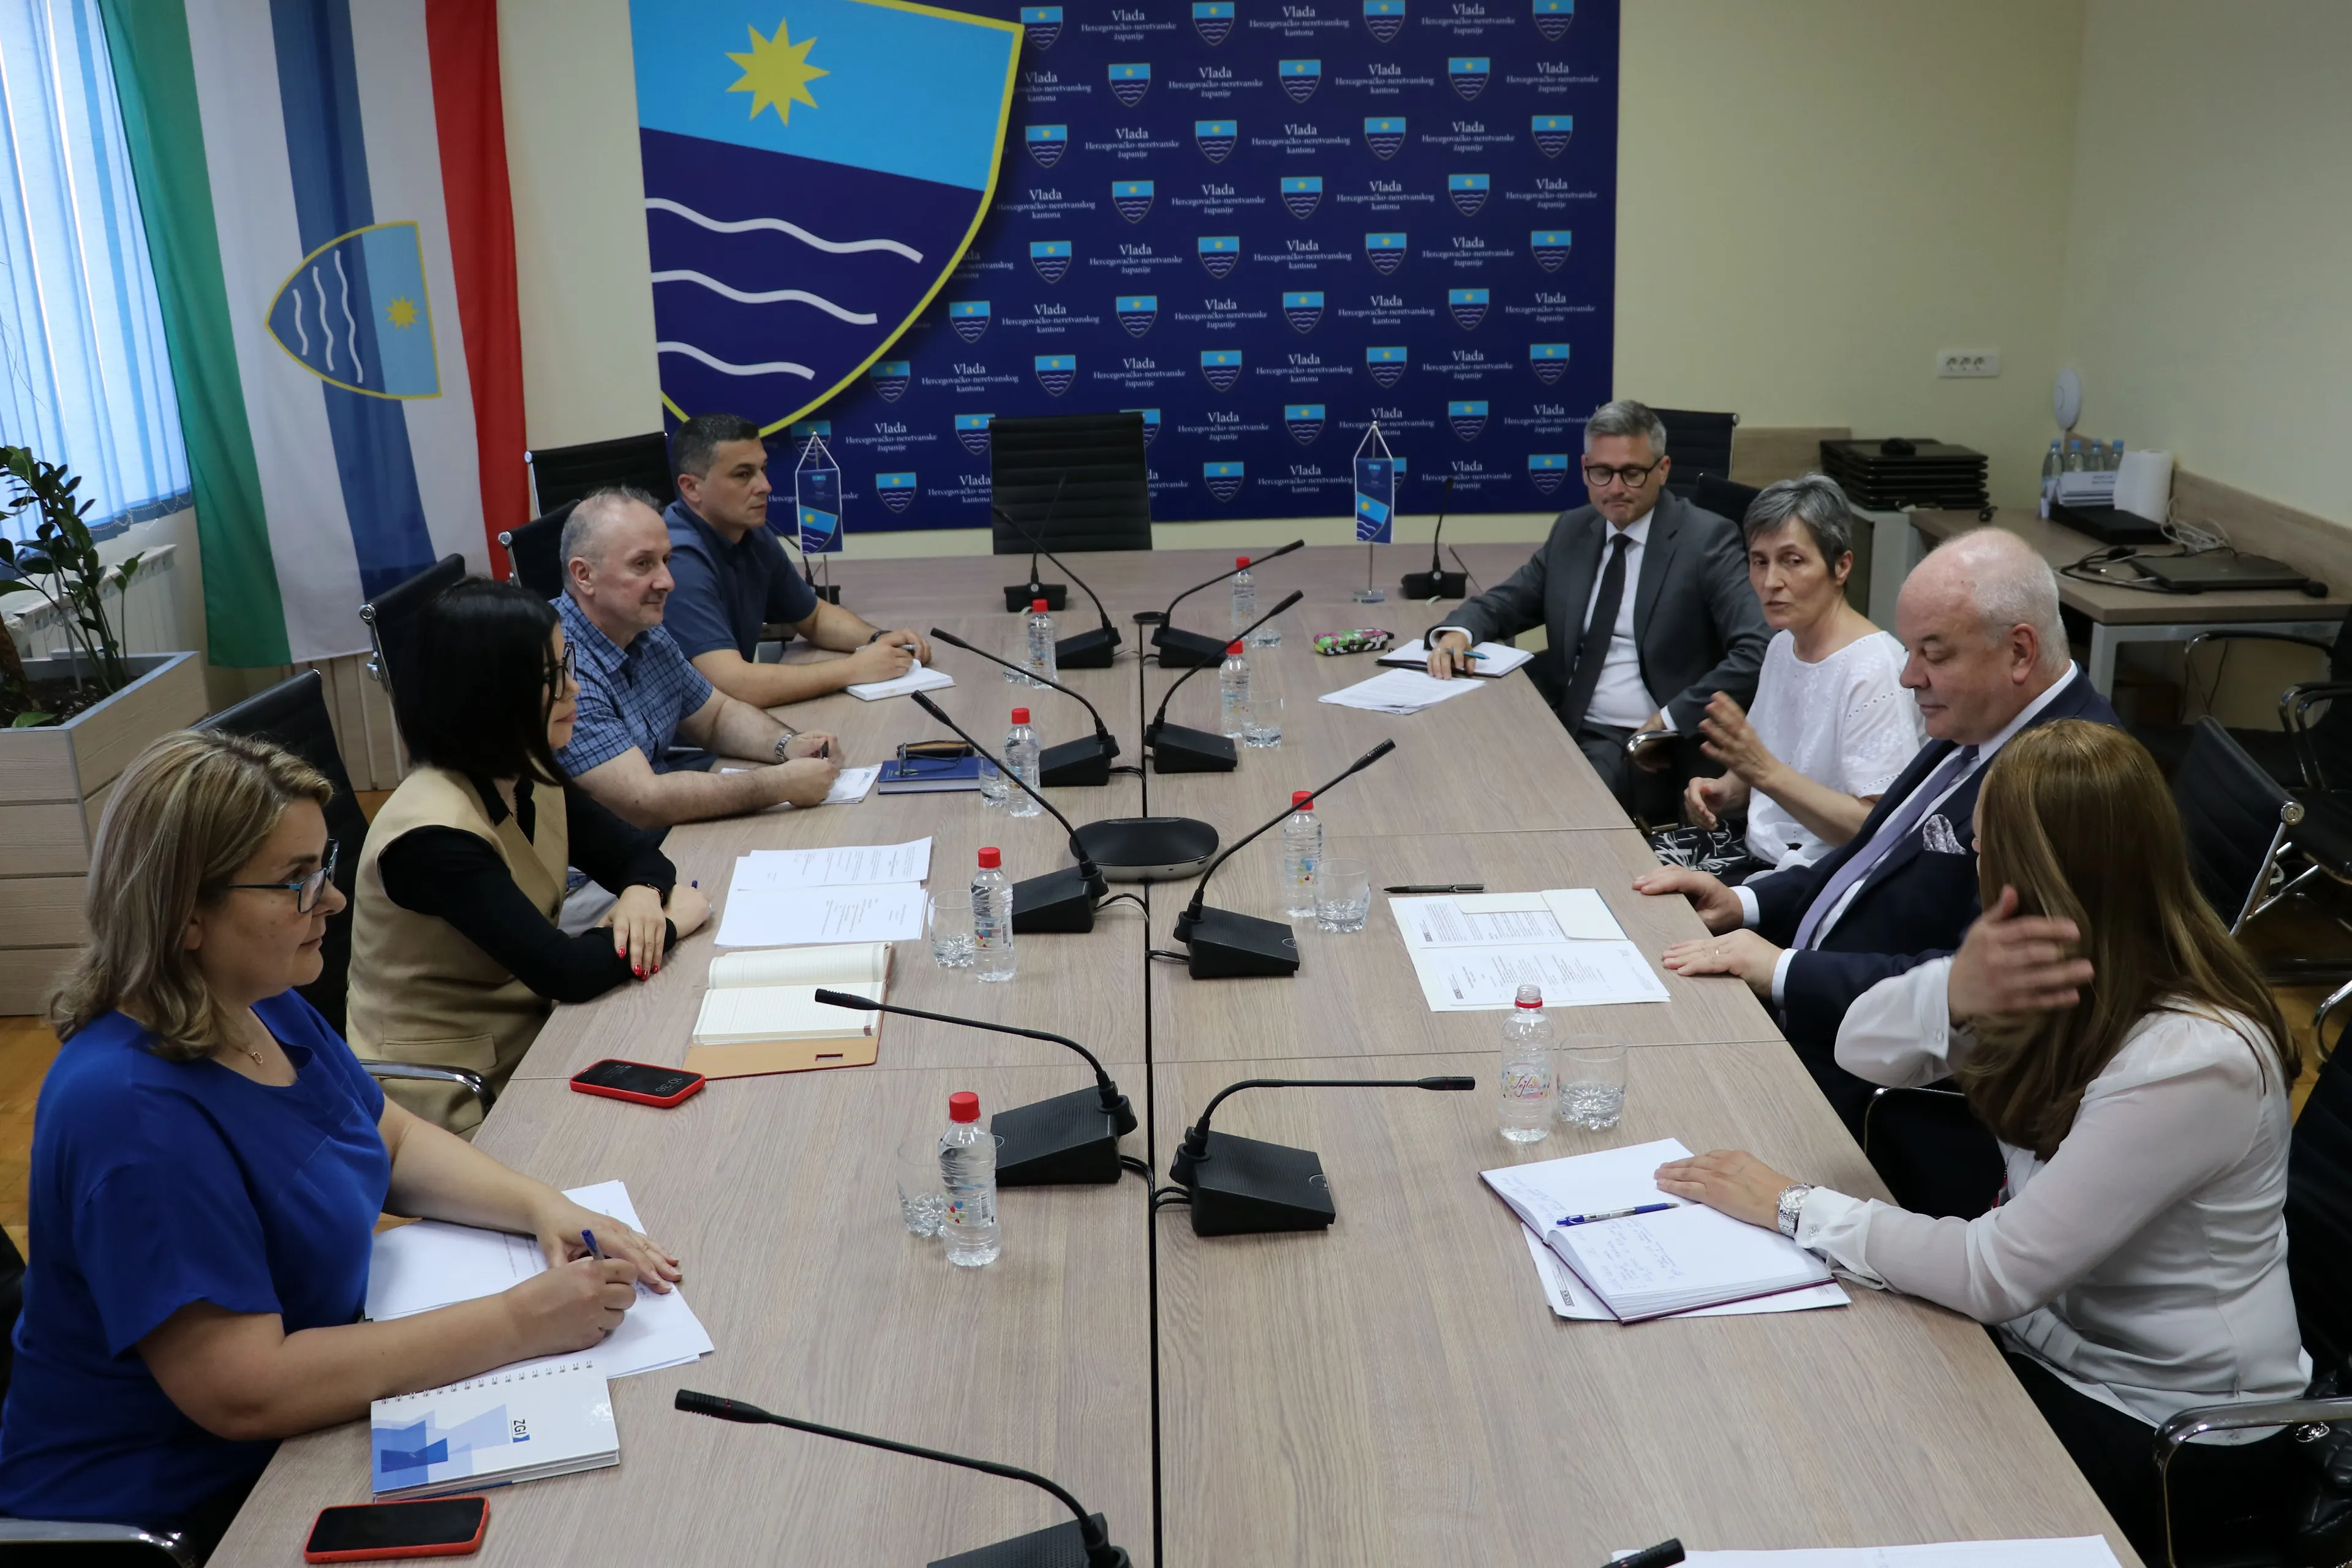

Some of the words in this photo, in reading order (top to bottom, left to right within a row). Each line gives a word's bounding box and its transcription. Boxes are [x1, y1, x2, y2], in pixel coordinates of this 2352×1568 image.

[1111, 9, 1145, 21] Vlada
[1283, 6, 1315, 18] Vlada
[1452, 3, 1485, 15] Vlada
[1199, 66, 1232, 79] Vlada
[1368, 63, 1401, 76] Vlada
[1537, 62, 1569, 74] Vlada
[1025, 71, 1058, 83] Vlada
[1284, 123, 1317, 136] Vlada
[1452, 121, 1485, 133] Vlada
[1115, 127, 1148, 140] Vlada
[1201, 183, 1235, 196] Vlada
[1369, 180, 1401, 192] Vlada
[1536, 178, 1568, 190] Vlada
[1029, 188, 1062, 201] Vlada
[1286, 239, 1319, 252] Vlada
[1452, 236, 1485, 248] Vlada
[1119, 243, 1152, 255] Vlada
[1205, 298, 1237, 310] Vlada
[1370, 295, 1403, 307] Vlada
[1535, 292, 1566, 304] Vlada
[1034, 303, 1066, 315] Vlada
[1288, 353, 1321, 365] Vlada
[1452, 350, 1484, 361] Vlada
[953, 363, 986, 375] Vlada
[1123, 357, 1155, 369] Vlada
[1371, 407, 1403, 419] Vlada
[1534, 404, 1564, 415] Vlada
[1208, 412, 1239, 423] Vlada
[875, 422, 907, 434] Vlada
[1290, 464, 1321, 475] Vlada
[1452, 461, 1482, 472] Vlada
[959, 473, 992, 486] Vlada
[655, 1078, 682, 1091] 10:36
[514, 1419, 527, 1435] ZGI
